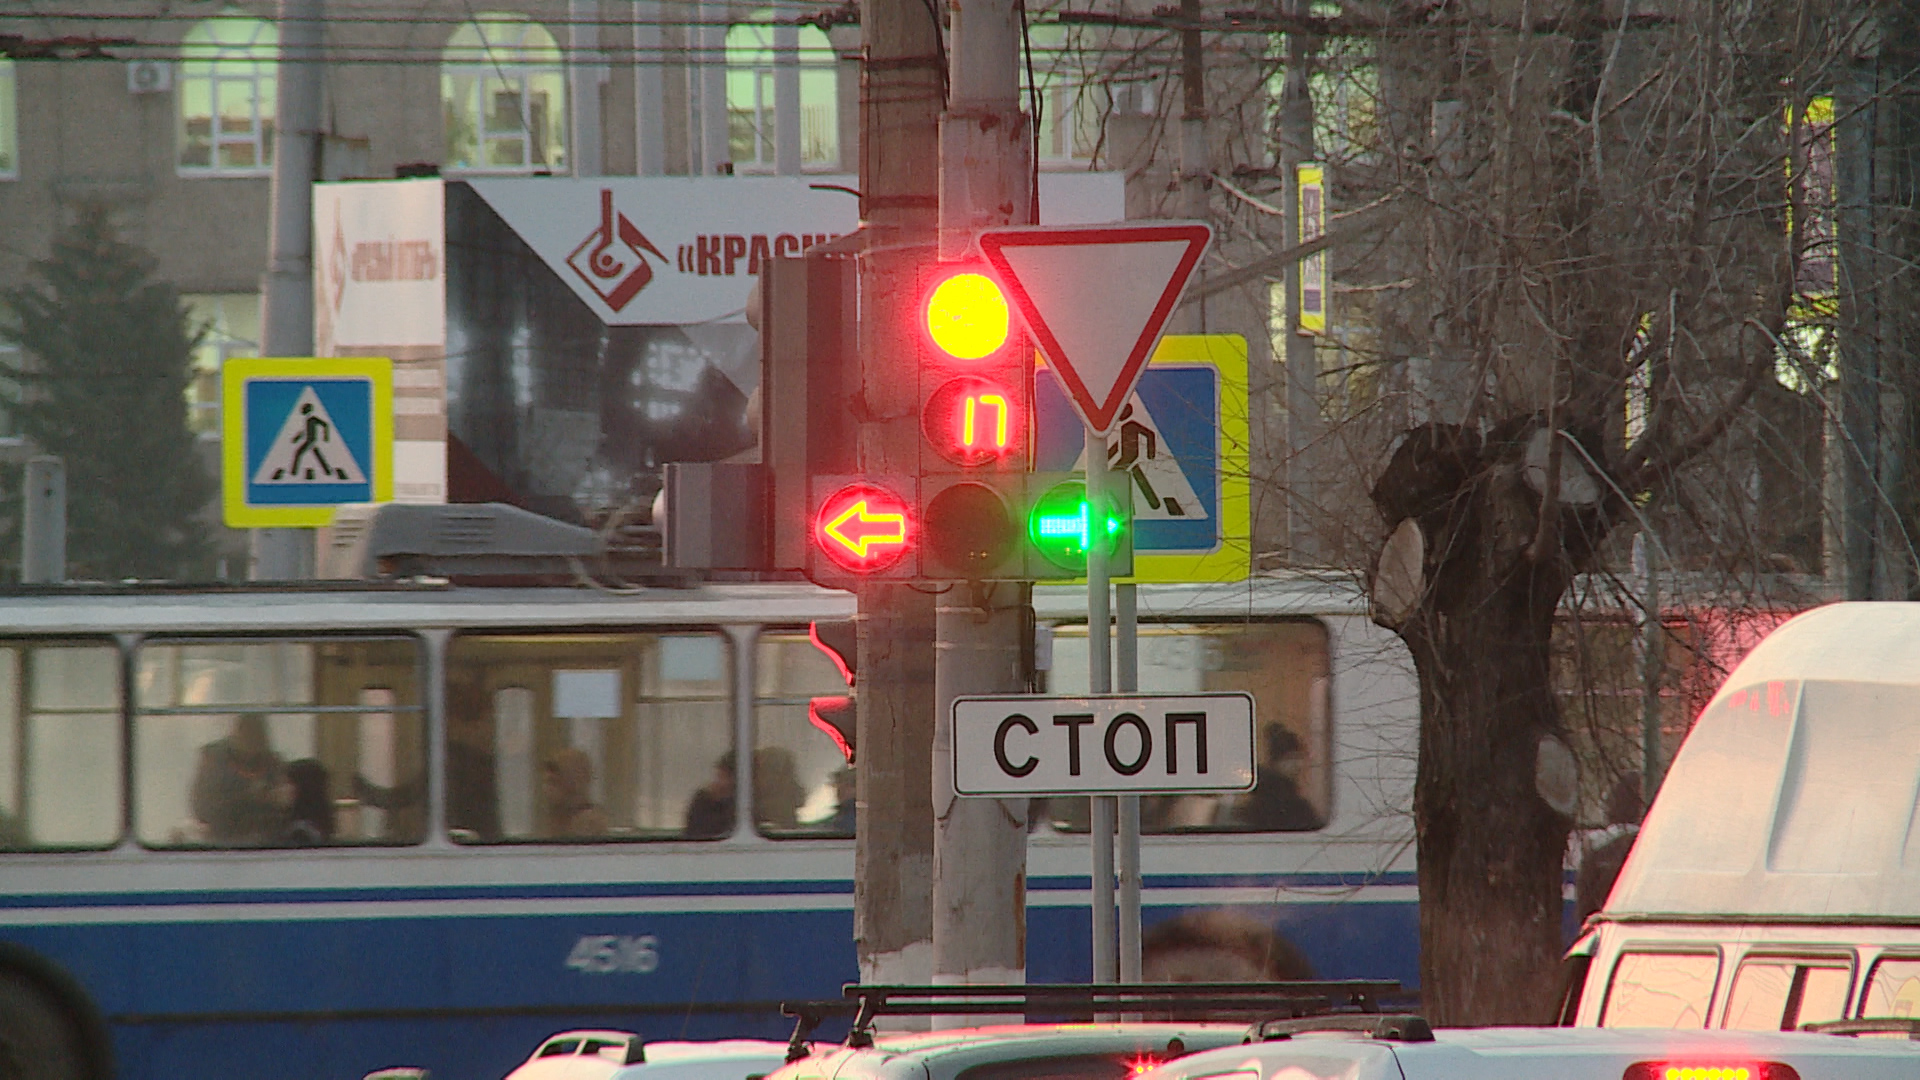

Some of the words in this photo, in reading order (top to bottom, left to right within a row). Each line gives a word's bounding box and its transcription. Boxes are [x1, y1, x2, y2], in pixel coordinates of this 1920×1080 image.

[963, 394, 1007, 447] 17
[993, 712, 1208, 778] СТОП
[565, 933, 660, 975] 4516
